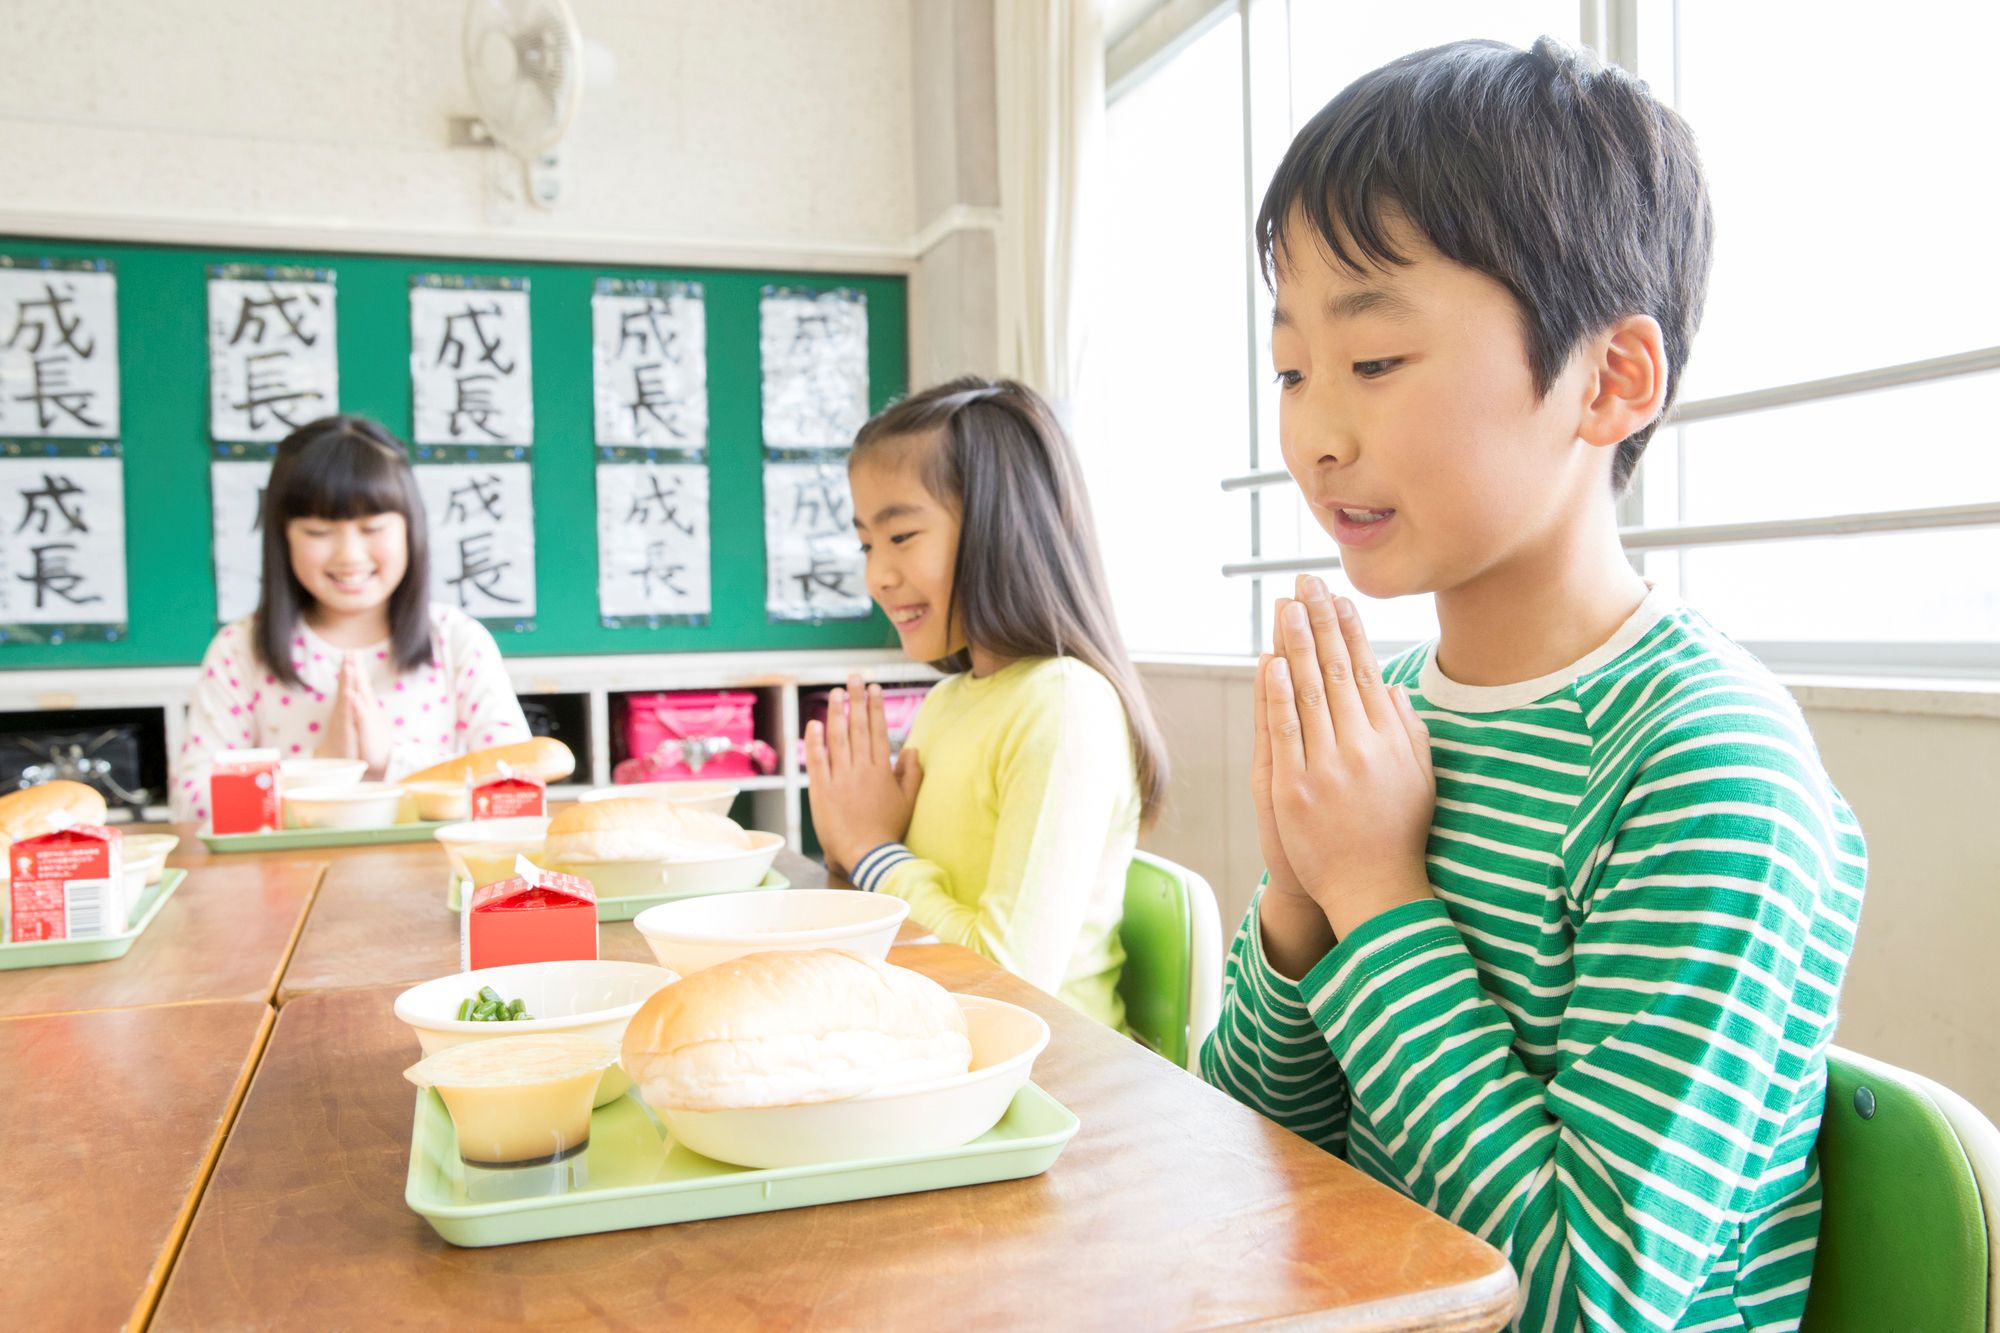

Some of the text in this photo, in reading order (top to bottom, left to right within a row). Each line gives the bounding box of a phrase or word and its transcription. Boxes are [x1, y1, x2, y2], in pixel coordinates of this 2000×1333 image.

[6, 283, 102, 429] 成長
[229, 282, 324, 431] 成長
[436, 302, 515, 439] 成長
[615, 300, 687, 439] 成長
[15, 473, 102, 608] 成長
[443, 474, 522, 607] 成長
[625, 474, 695, 598] 成長
